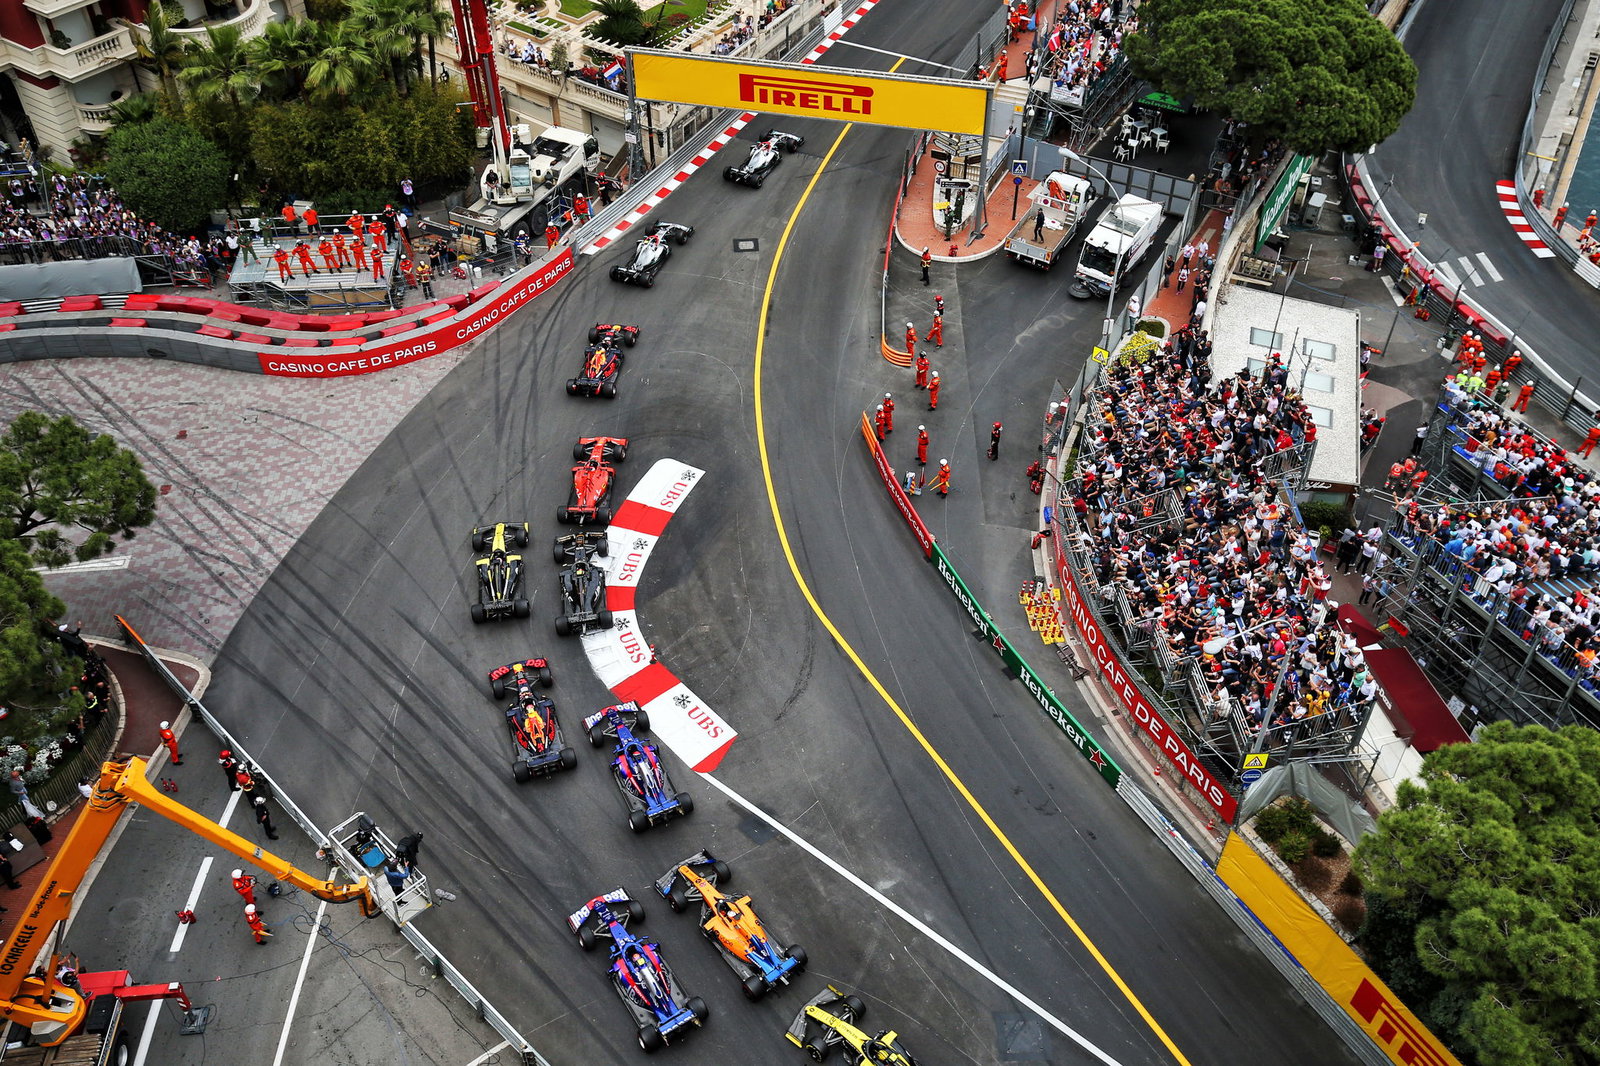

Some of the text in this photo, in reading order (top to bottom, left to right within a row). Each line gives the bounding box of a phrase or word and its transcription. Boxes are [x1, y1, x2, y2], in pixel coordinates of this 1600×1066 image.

[739, 73, 874, 115] PIRELLI
[456, 256, 571, 340] CASINO CAFE DE PARIS
[268, 340, 437, 374] CASINO CAFE DE PARIS
[660, 482, 688, 508] UBS
[618, 552, 642, 582] UBS
[938, 557, 988, 636] Heineken
[619, 631, 646, 664] UBS
[1062, 567, 1223, 807] CASINO CAFE DE PARIS
[687, 706, 724, 739] UBS
[1020, 666, 1085, 749] Heineken
